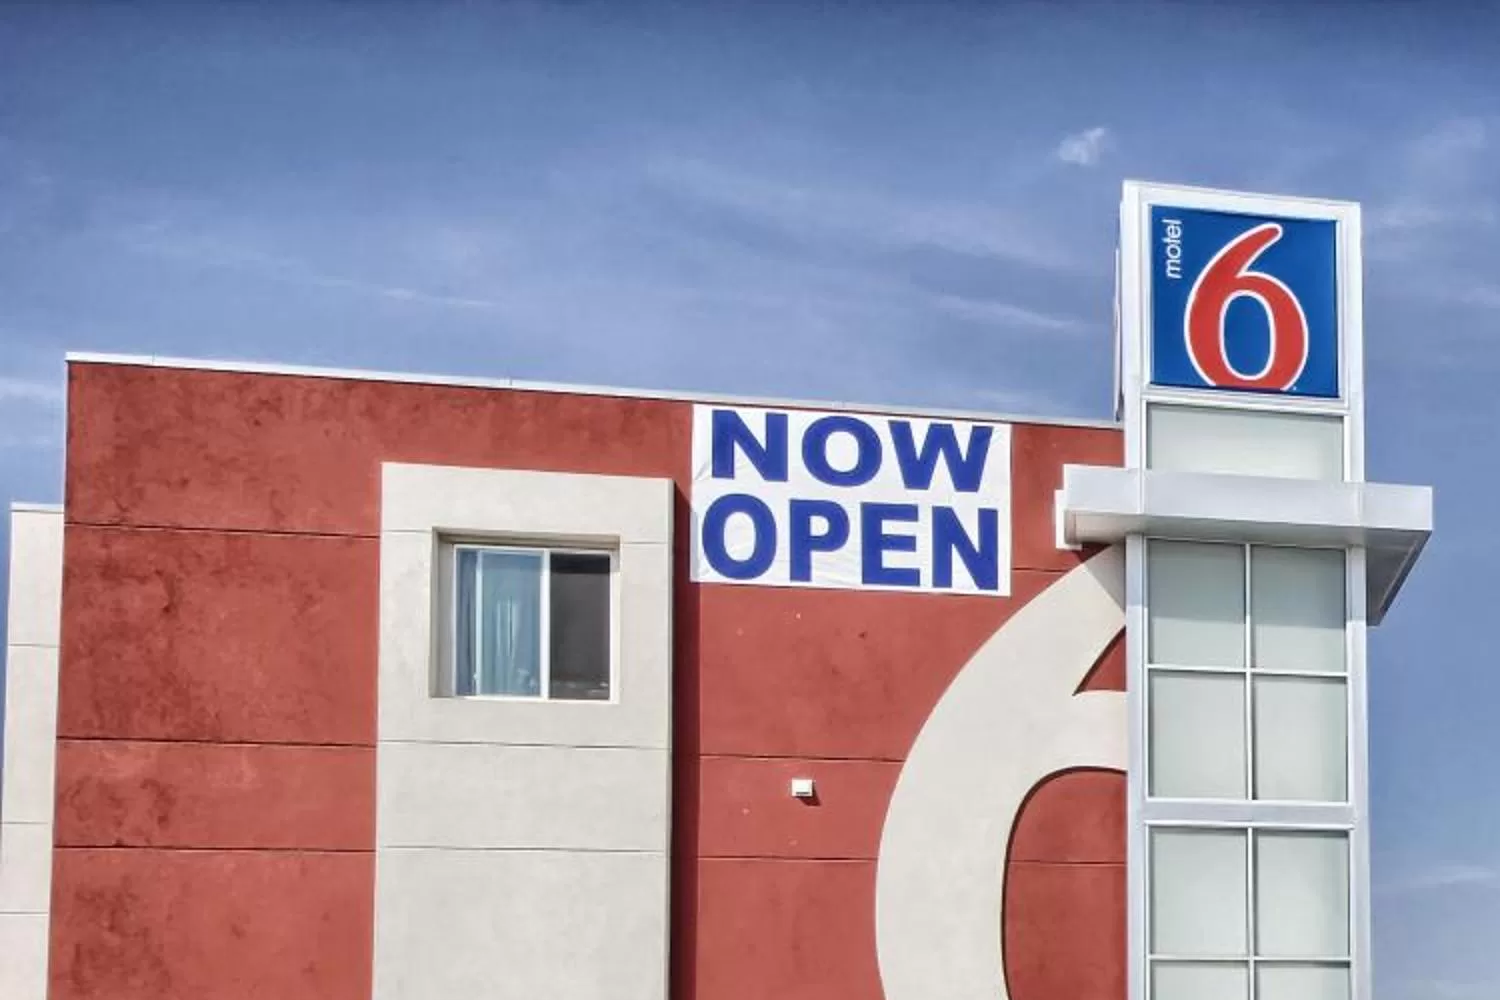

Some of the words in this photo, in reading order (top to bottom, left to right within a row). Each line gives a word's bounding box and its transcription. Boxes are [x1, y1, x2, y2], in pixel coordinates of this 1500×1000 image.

[1162, 218, 1183, 280] motel
[1183, 222, 1309, 391] 6
[711, 409, 994, 493] NOW
[701, 493, 999, 592] OPEN
